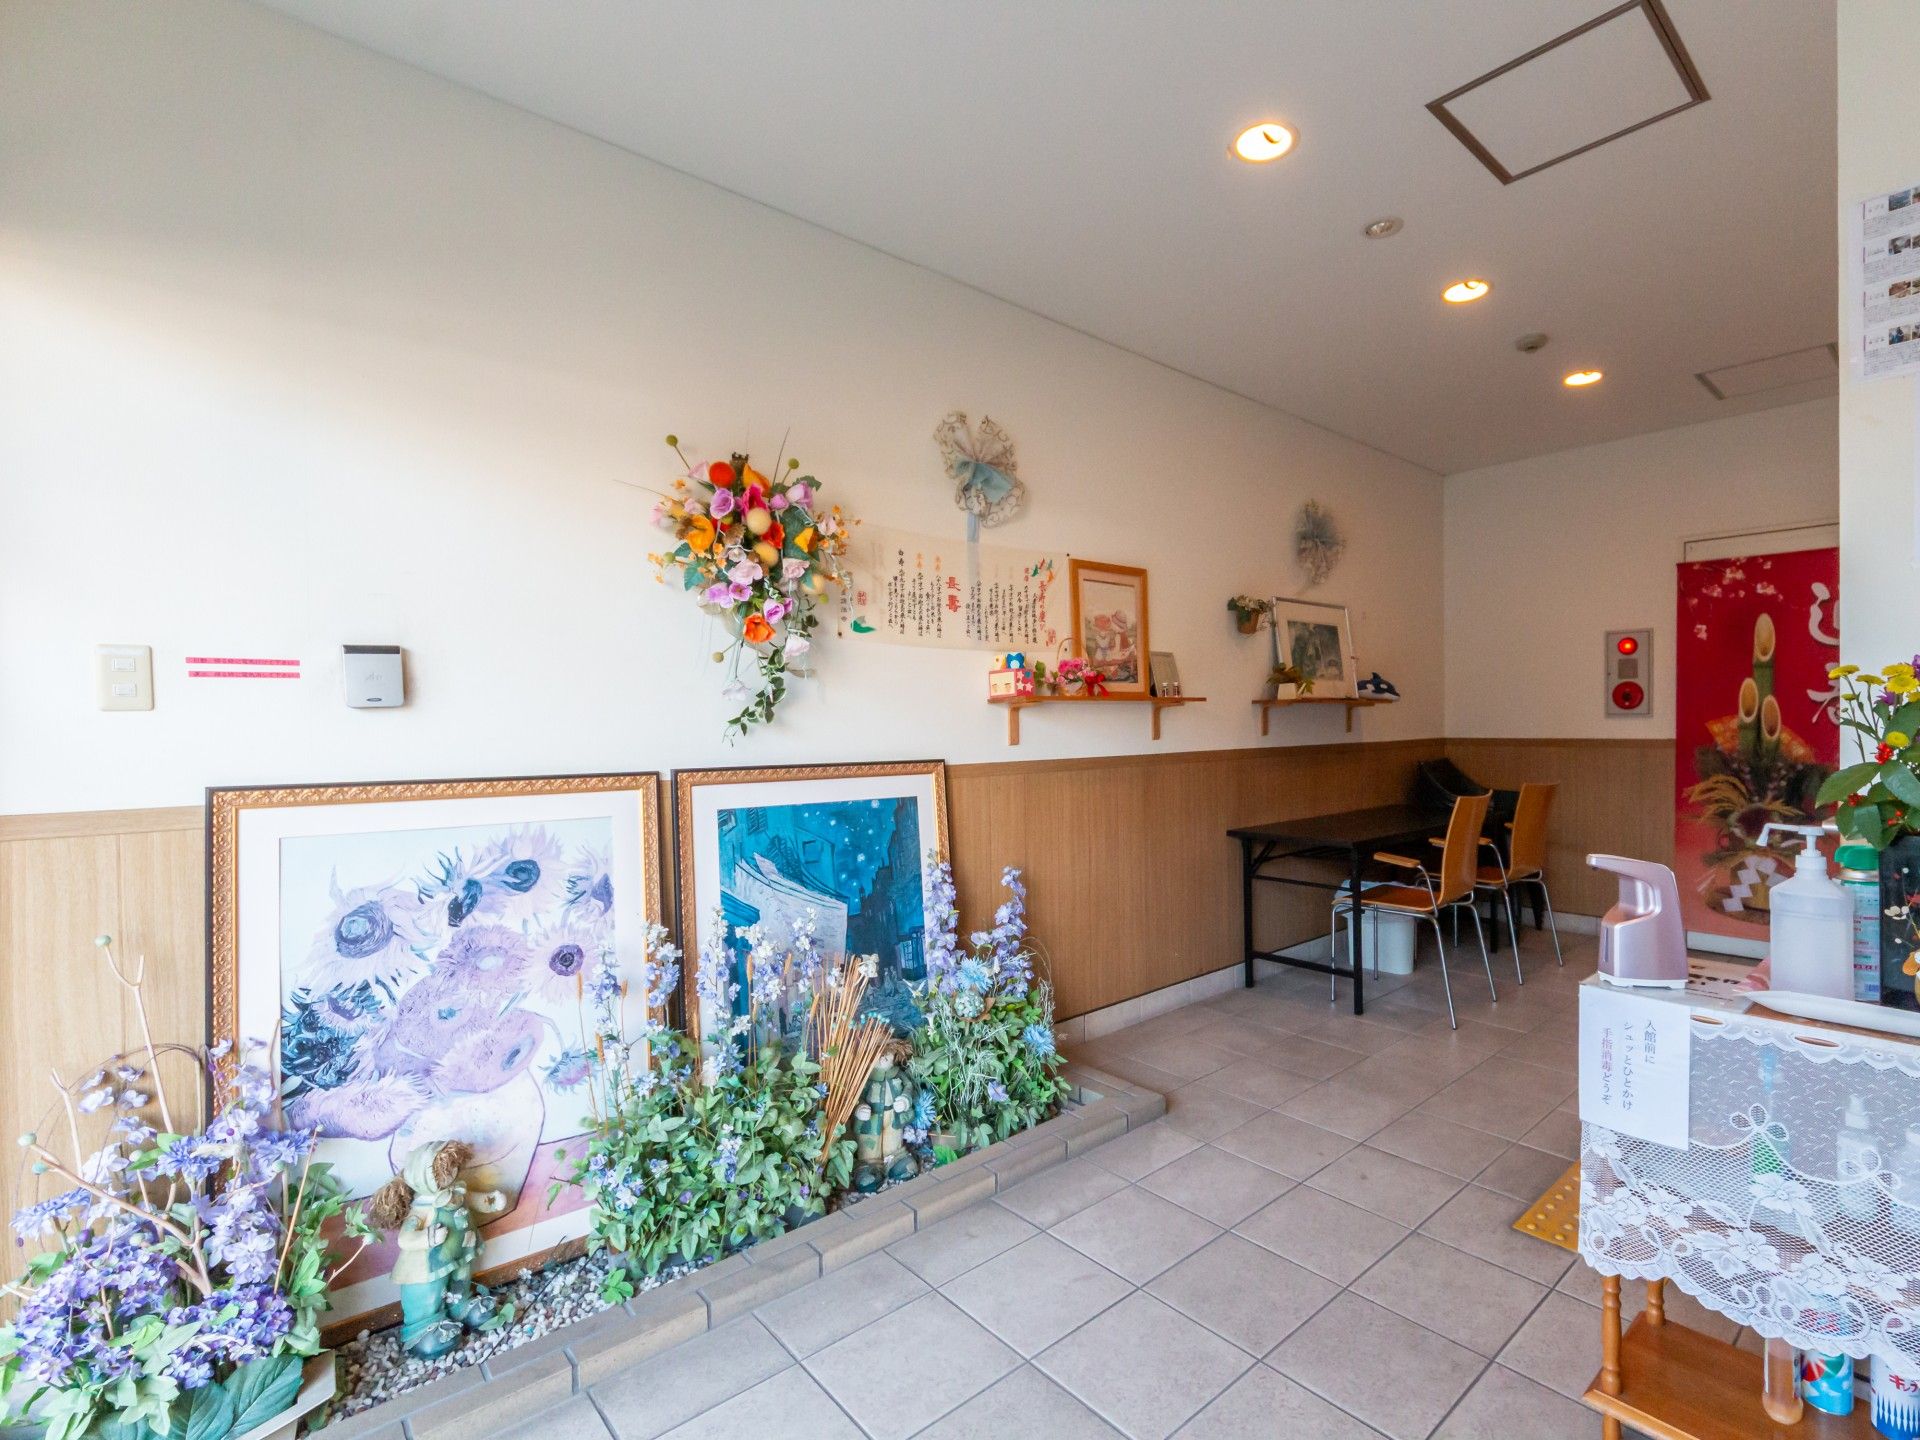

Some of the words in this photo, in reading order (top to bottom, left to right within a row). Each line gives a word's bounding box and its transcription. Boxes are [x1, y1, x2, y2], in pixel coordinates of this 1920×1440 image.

[1601, 1027, 1613, 1105] 手指消毒どうぞ
[1622, 1021, 1634, 1111] シュッとひとかけ
[1644, 1020, 1657, 1064] 入館前に
